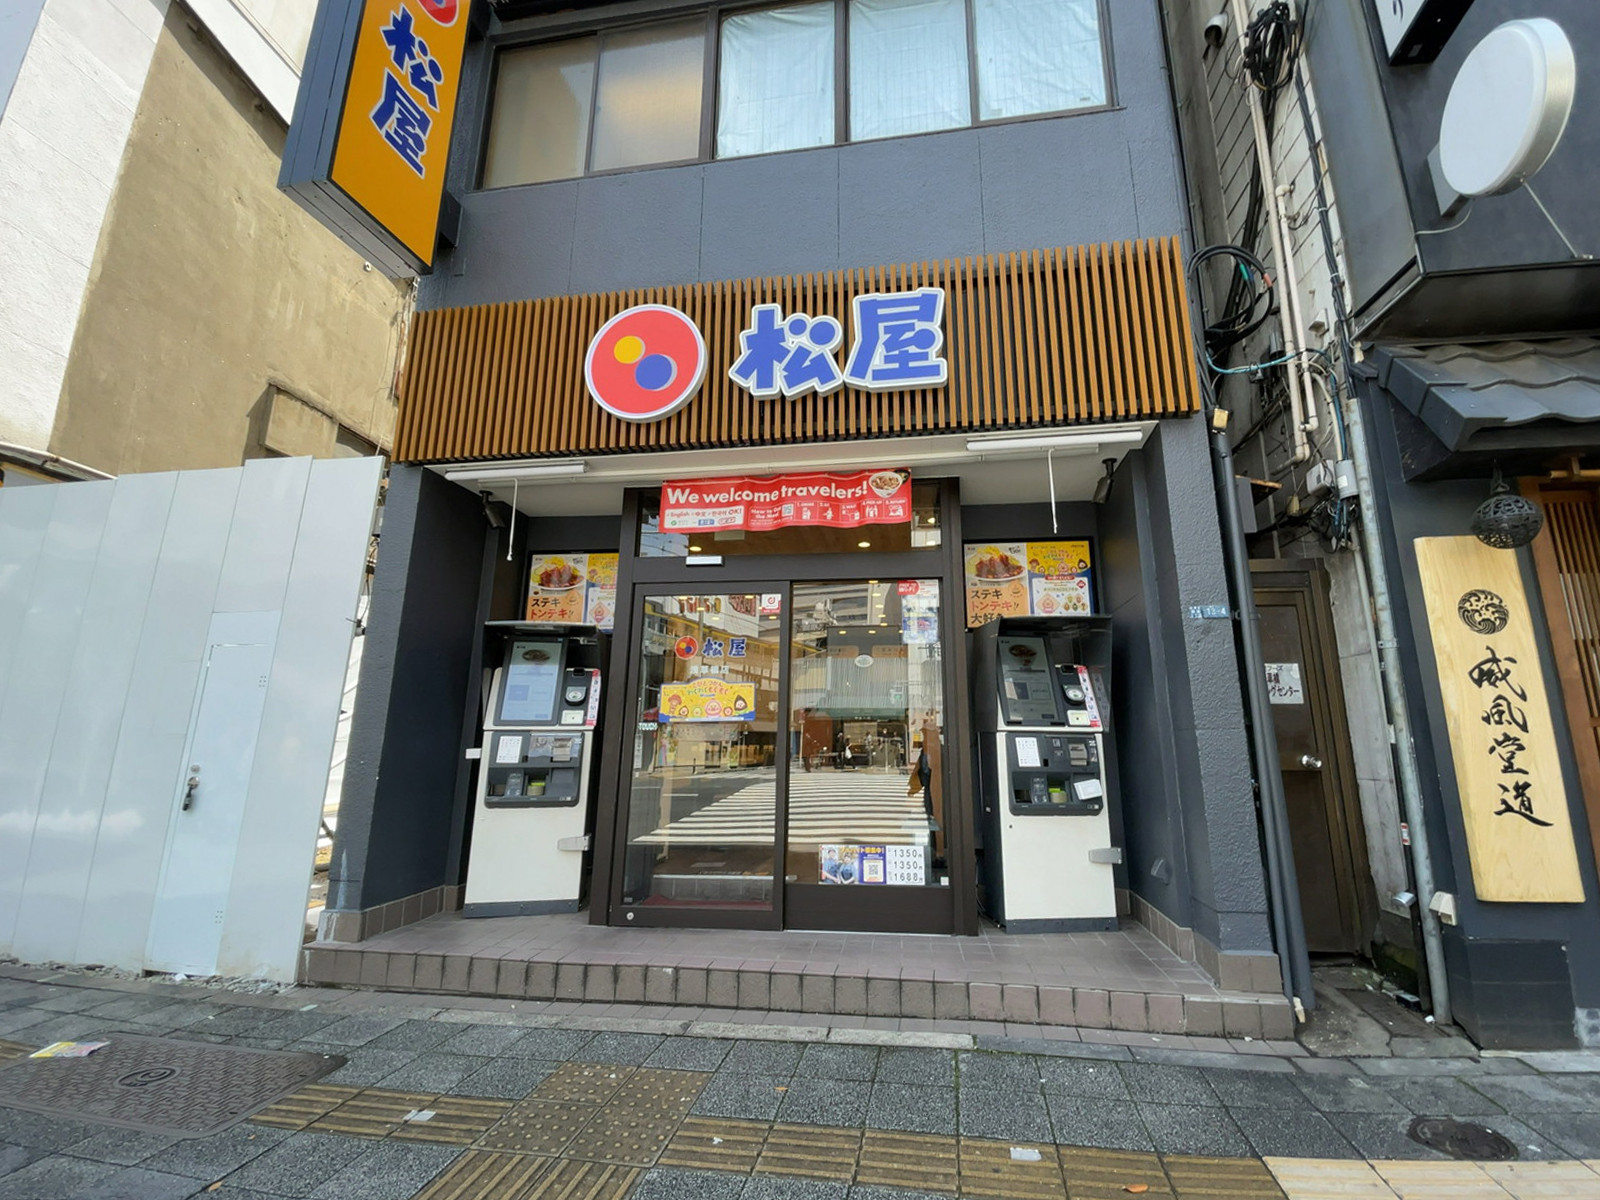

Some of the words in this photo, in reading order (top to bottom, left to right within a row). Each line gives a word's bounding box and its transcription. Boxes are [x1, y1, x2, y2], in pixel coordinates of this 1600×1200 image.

[369, 4, 444, 179] 松屋
[729, 287, 948, 400] 松屋
[667, 488, 699, 504] We
[702, 487, 779, 503] welcome
[781, 481, 868, 499] travelers!
[531, 597, 560, 608] ステキ
[971, 589, 1003, 600] ステキ
[702, 637, 747, 658] 松屋
